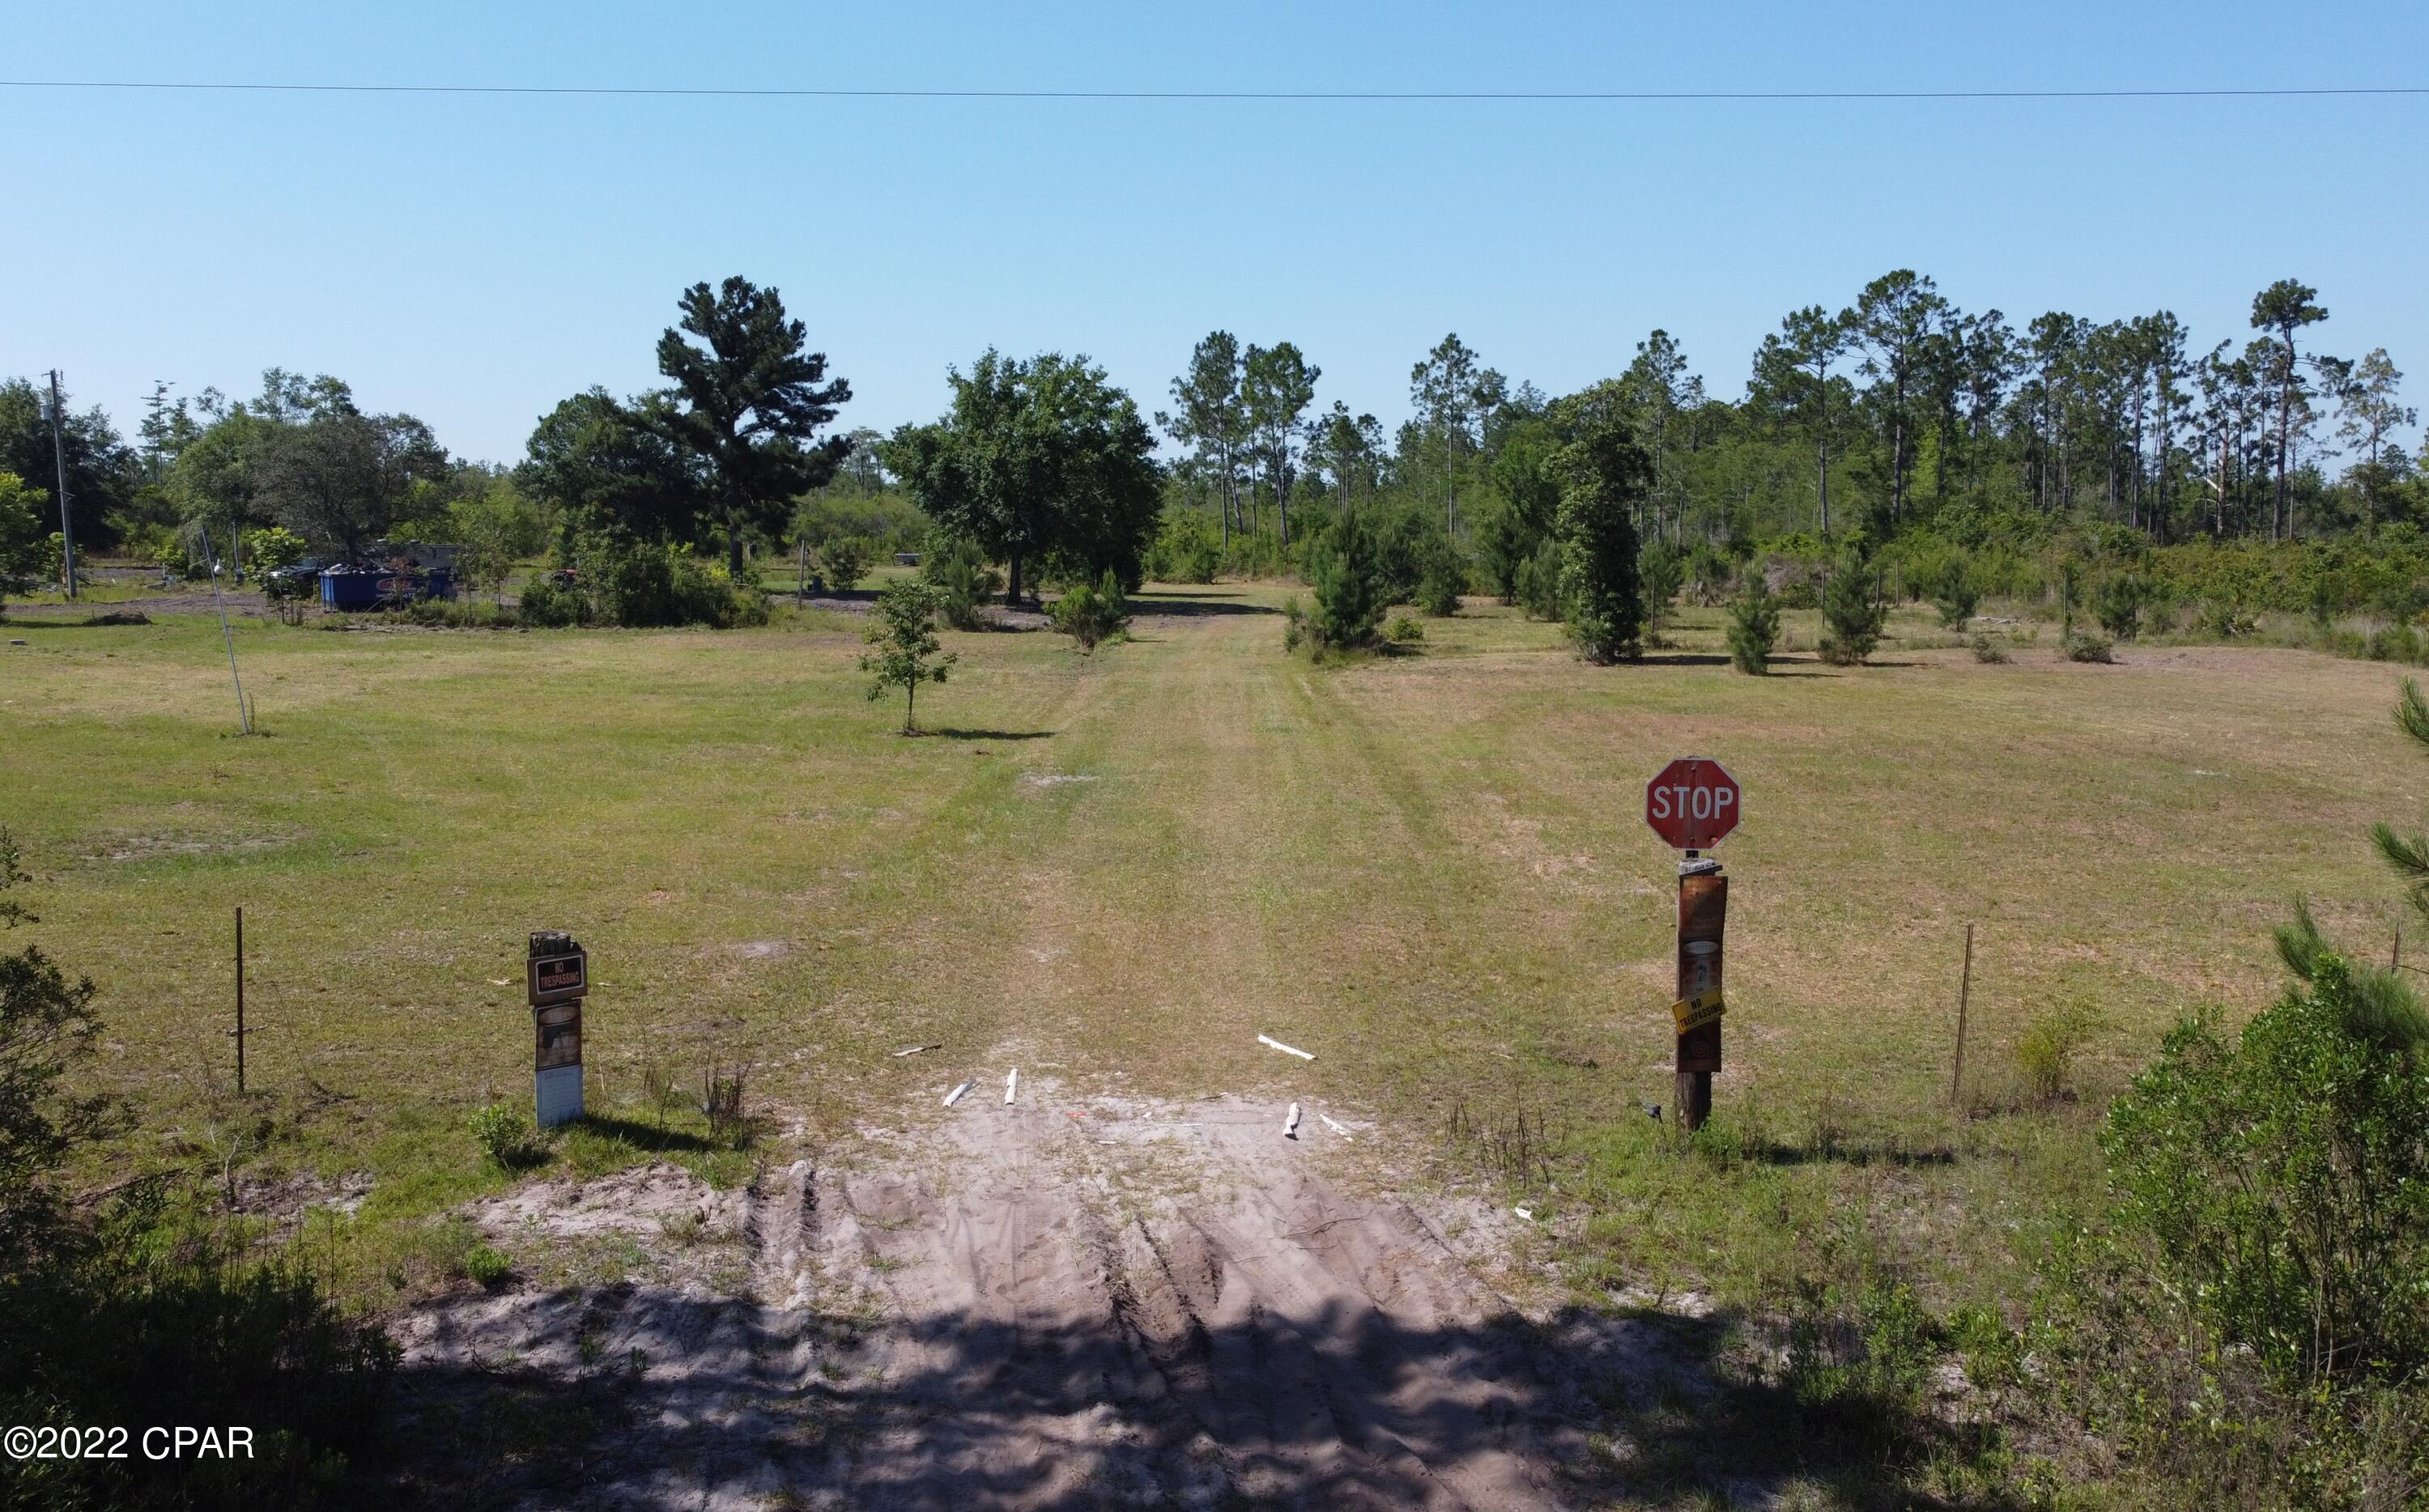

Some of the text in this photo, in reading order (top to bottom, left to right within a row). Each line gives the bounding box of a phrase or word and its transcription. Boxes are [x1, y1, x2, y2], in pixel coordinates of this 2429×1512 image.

[1652, 785, 1734, 821] STOP
[555, 962, 564, 974] NO
[540, 971, 580, 988] TRESPASSING
[1690, 997, 1702, 1010] NO
[1678, 1002, 1722, 1029] TRESPASSING
